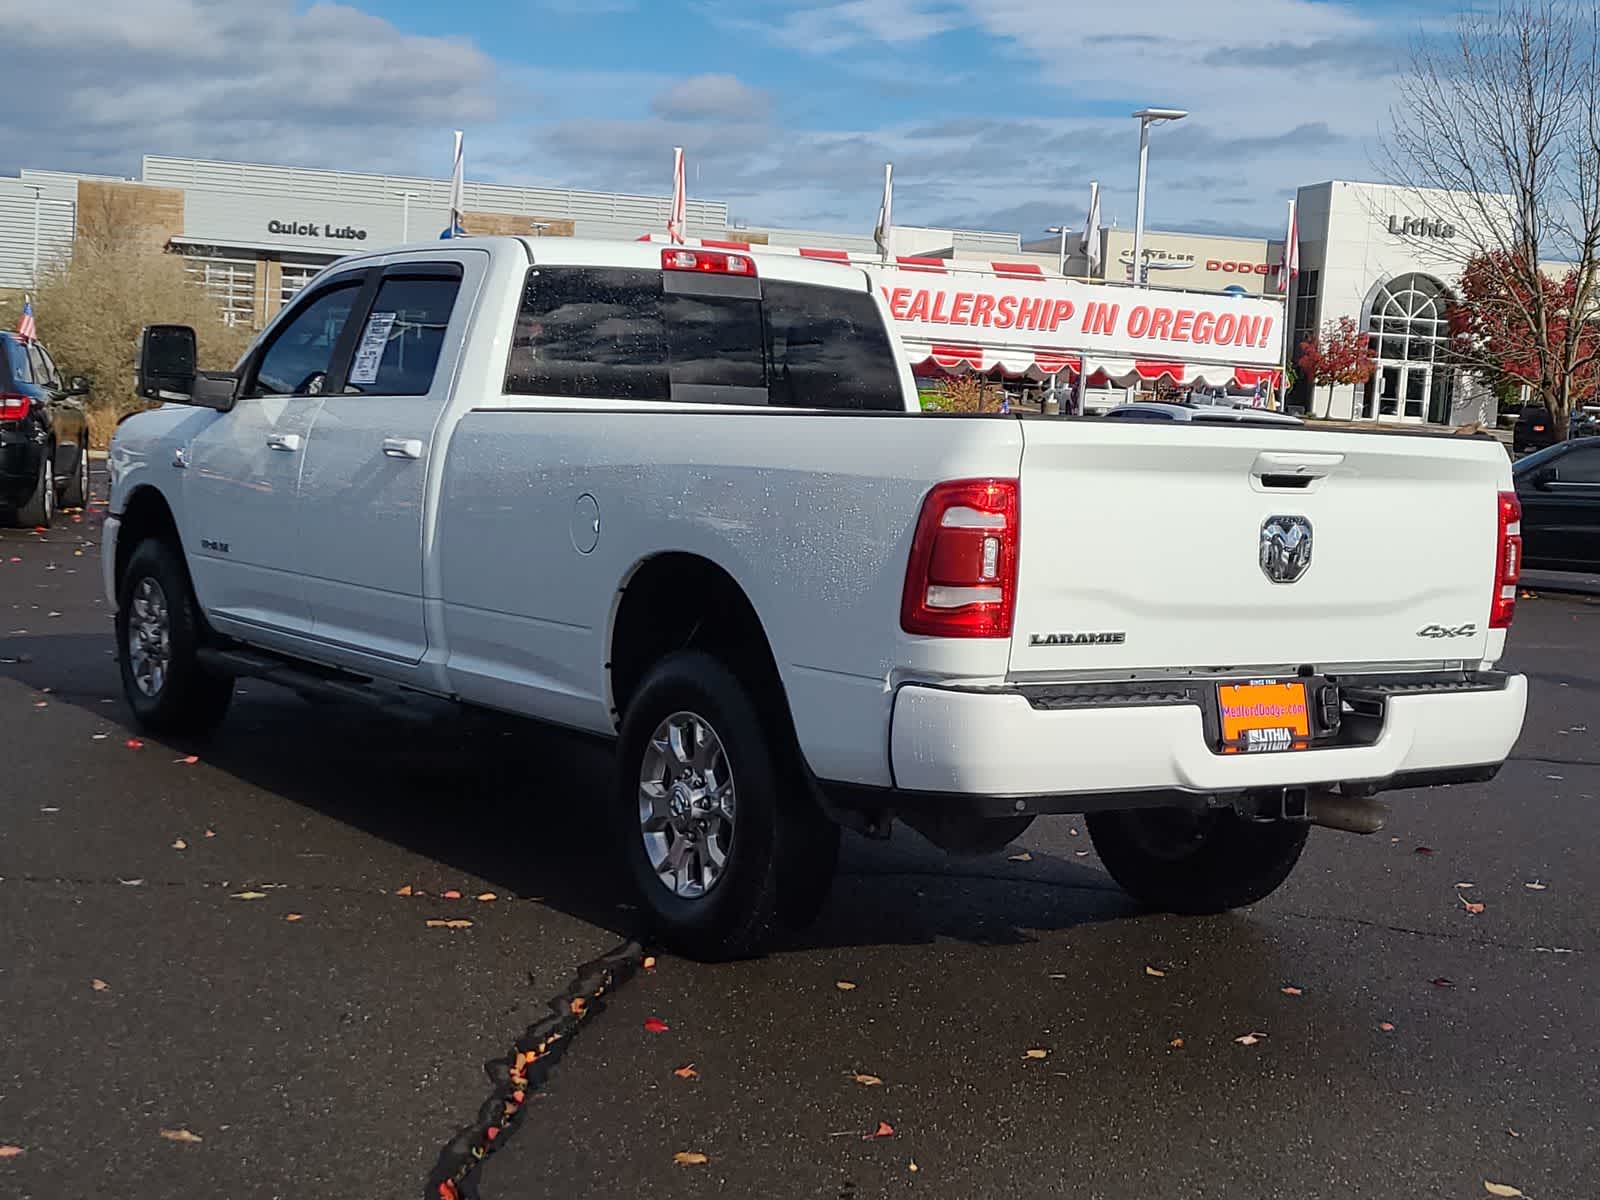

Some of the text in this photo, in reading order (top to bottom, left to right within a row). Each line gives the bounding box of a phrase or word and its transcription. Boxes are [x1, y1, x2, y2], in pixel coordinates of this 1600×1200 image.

[268, 219, 367, 241] Quick Lube
[1389, 214, 1455, 239] Lithia
[880, 286, 1274, 348] EALERSHIP IN OREGON!
[1029, 632, 1126, 646] LARAMIE
[1257, 727, 1292, 743] LITHIA
